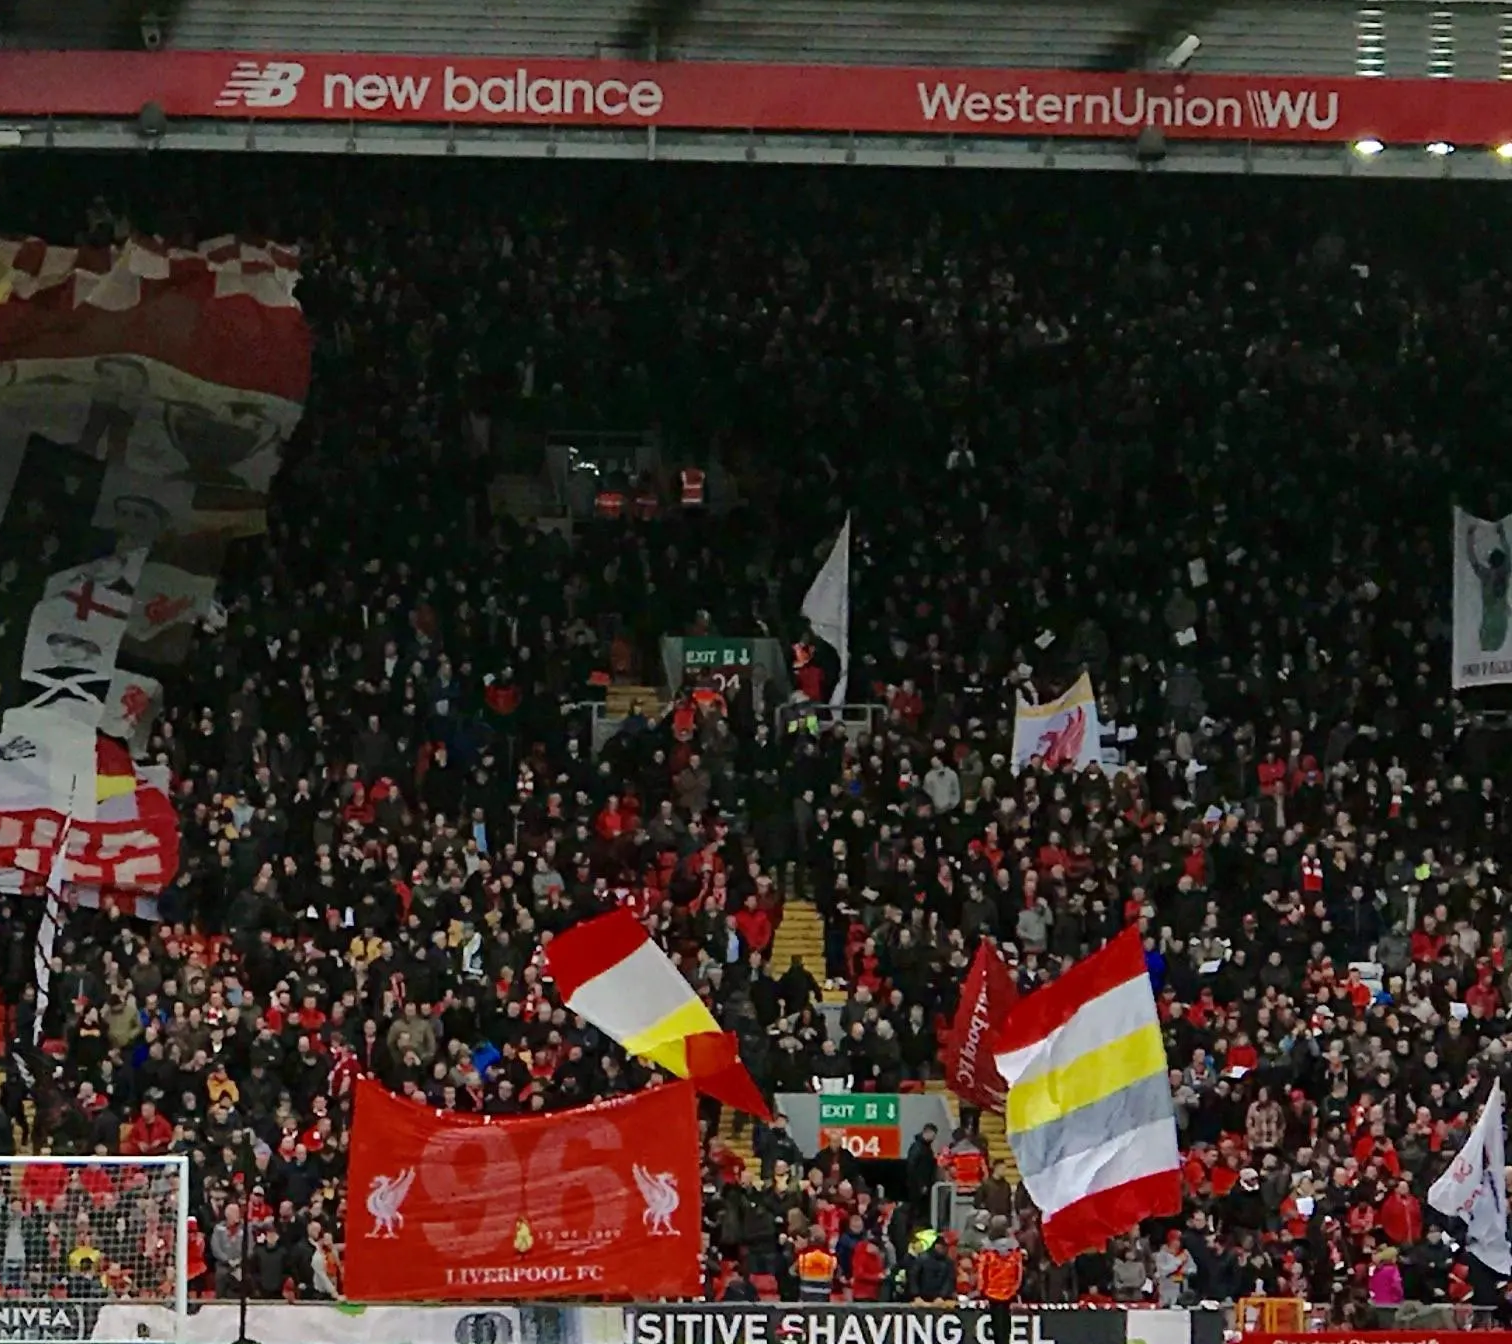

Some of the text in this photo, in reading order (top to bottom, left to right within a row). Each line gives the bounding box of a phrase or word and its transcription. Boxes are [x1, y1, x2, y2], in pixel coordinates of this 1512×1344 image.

[323, 71, 430, 110] new
[444, 67, 664, 117] balance
[917, 82, 1339, 131] WesternUnion WU
[685, 649, 717, 664] EXIT
[821, 1104, 855, 1119] EXIT
[420, 1117, 630, 1259] 96
[446, 1264, 605, 1285] LIVERPOOL FC
